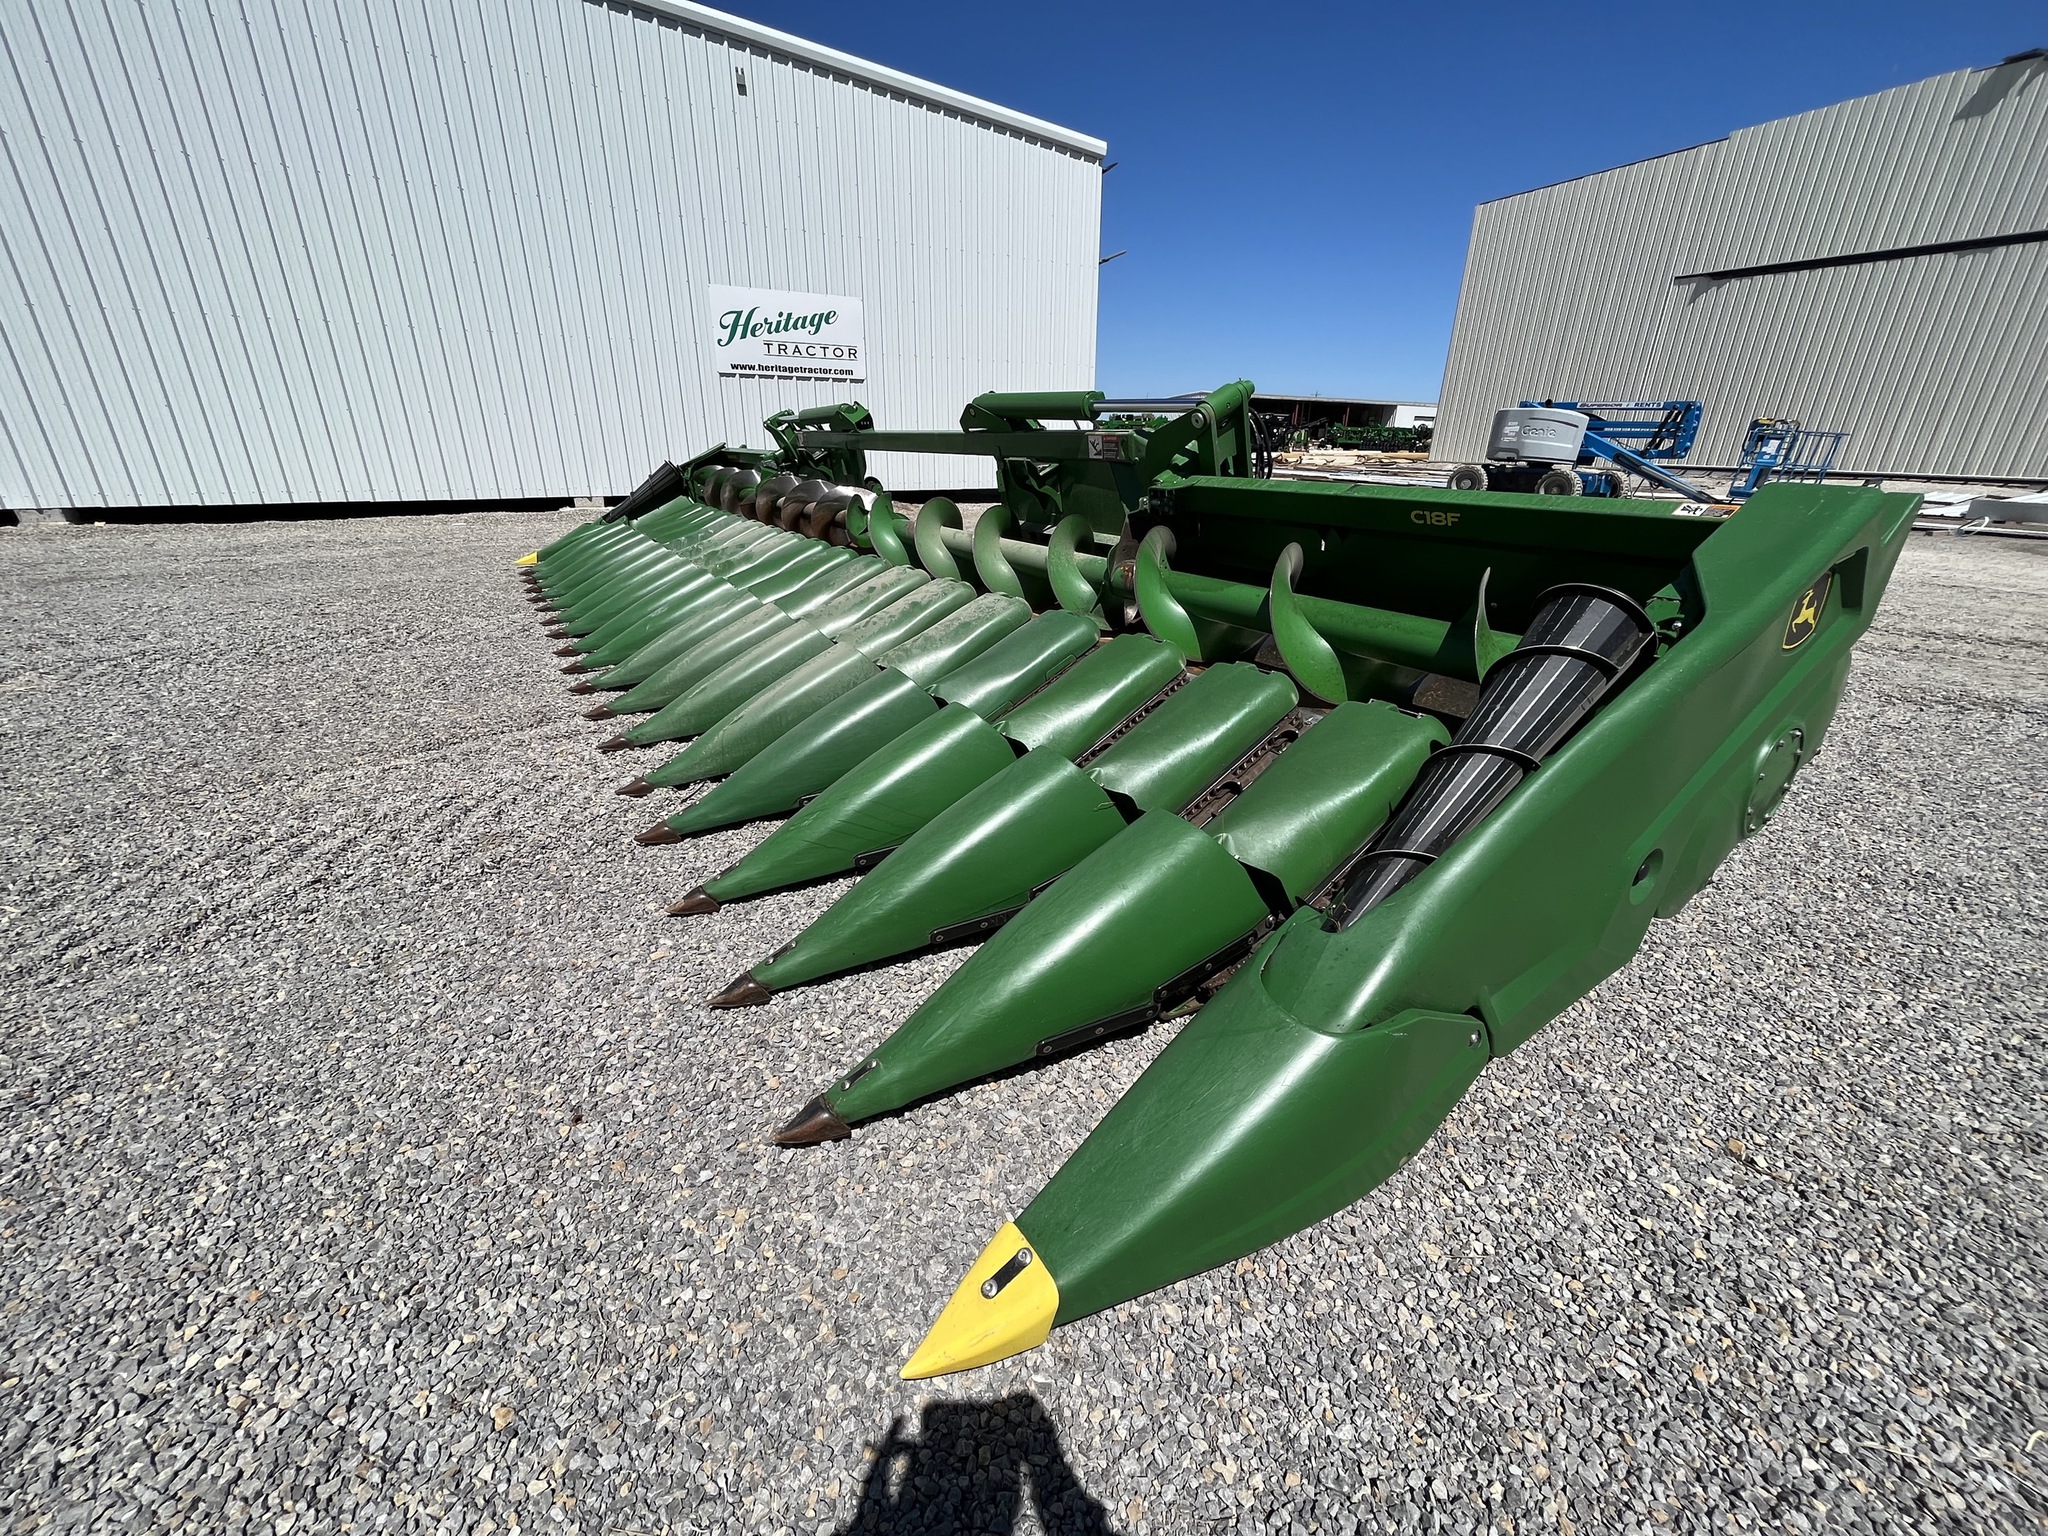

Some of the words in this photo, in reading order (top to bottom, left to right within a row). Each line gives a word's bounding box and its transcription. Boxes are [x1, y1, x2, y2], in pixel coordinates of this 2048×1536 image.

[717, 306, 839, 347] Heritage
[763, 342, 858, 359] TRACTOR
[730, 362, 854, 376] www.heritagetractor.com
[1521, 424, 1557, 438] Genie
[1410, 510, 1461, 526] C18F
